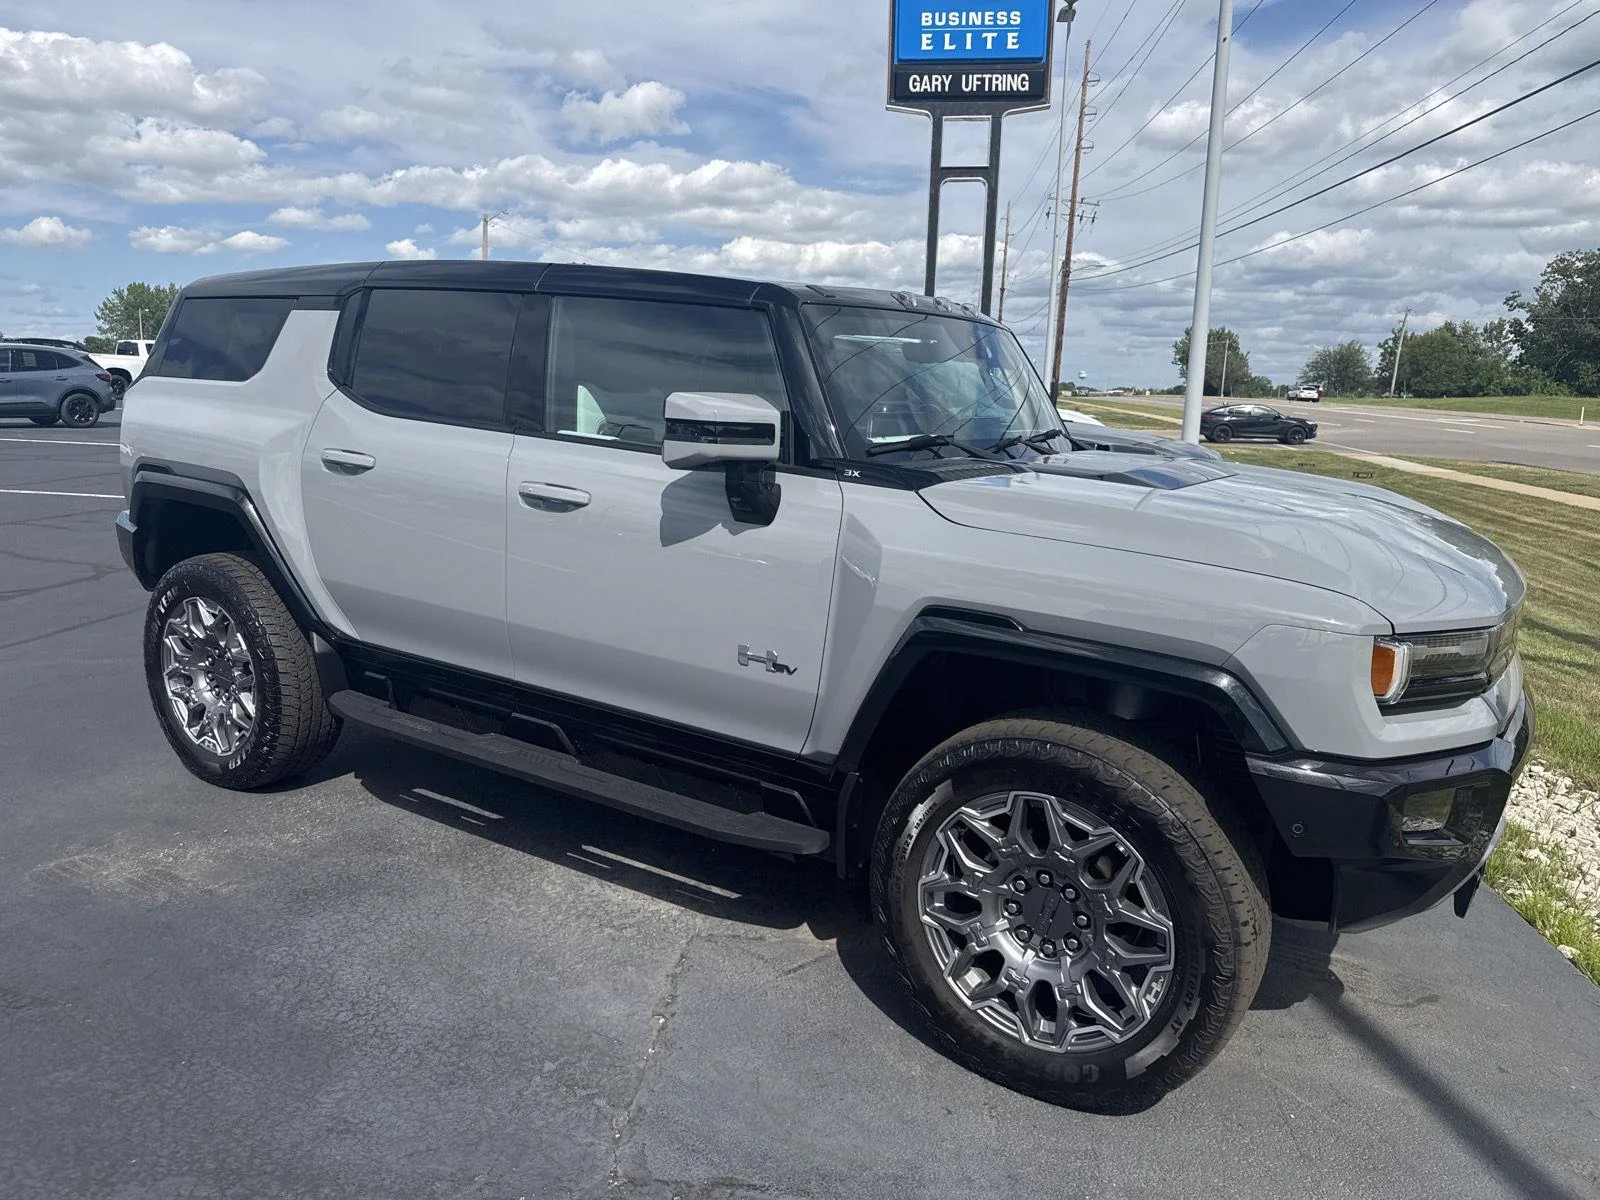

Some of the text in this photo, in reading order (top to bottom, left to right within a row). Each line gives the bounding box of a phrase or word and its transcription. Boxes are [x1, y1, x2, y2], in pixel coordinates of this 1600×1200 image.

[921, 11, 1021, 26] BUSINESS
[921, 32, 1020, 50] ELITE
[908, 73, 1030, 93] GARY UFTRING
[844, 469, 861, 478] 3X
